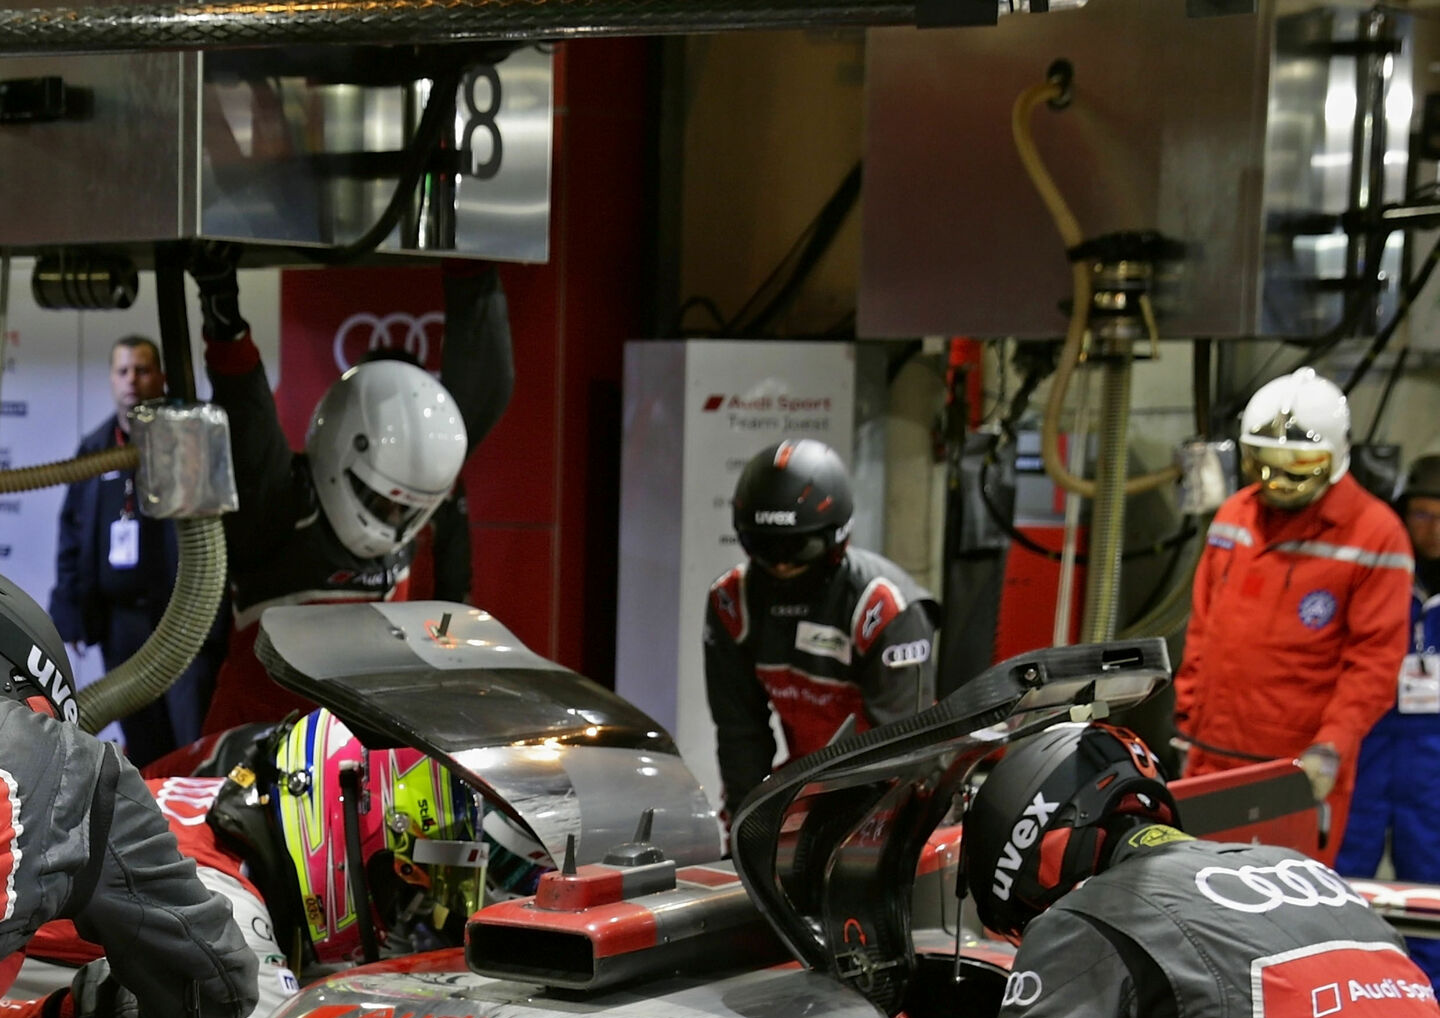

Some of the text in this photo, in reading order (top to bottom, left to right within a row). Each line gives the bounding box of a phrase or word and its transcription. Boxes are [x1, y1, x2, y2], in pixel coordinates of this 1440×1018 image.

[729, 396, 832, 413] Audi Sport
[755, 510, 796, 526] uvex
[27, 644, 78, 726] uve
[992, 791, 1060, 901] uvex
[1348, 979, 1402, 1002] Audi
